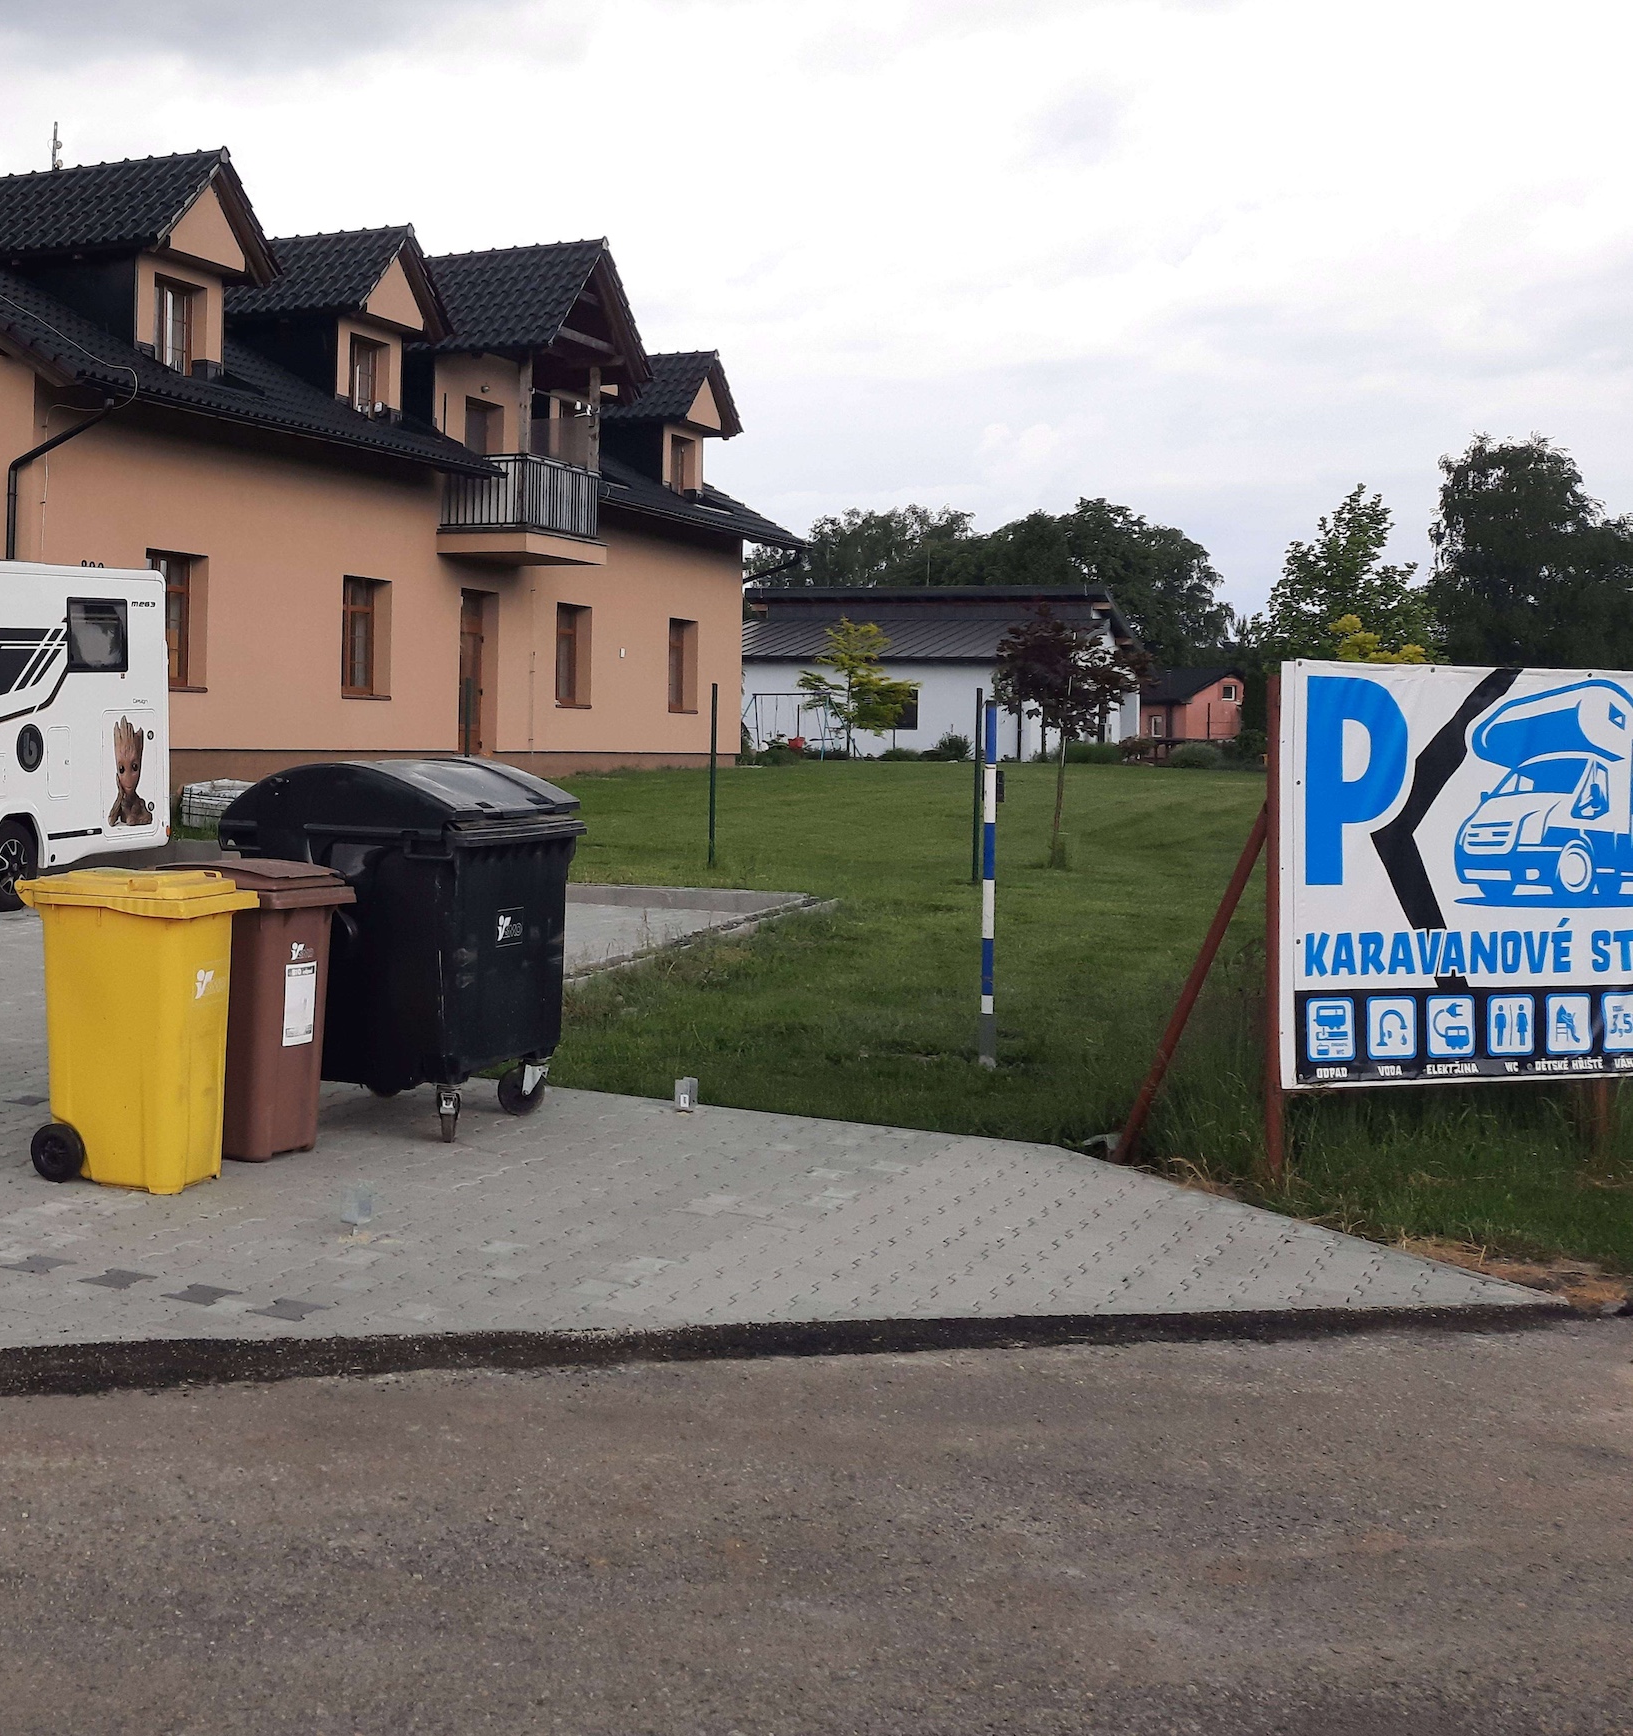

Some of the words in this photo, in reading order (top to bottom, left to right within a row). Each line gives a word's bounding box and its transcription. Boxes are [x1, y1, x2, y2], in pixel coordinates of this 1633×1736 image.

[1305, 675, 1408, 885] P
[1305, 918, 1573, 977] KARAVANOVÉ
[1316, 1066, 1348, 1079] ODPAD
[1377, 1065, 1403, 1077] VODA
[1504, 1062, 1519, 1073] WC
